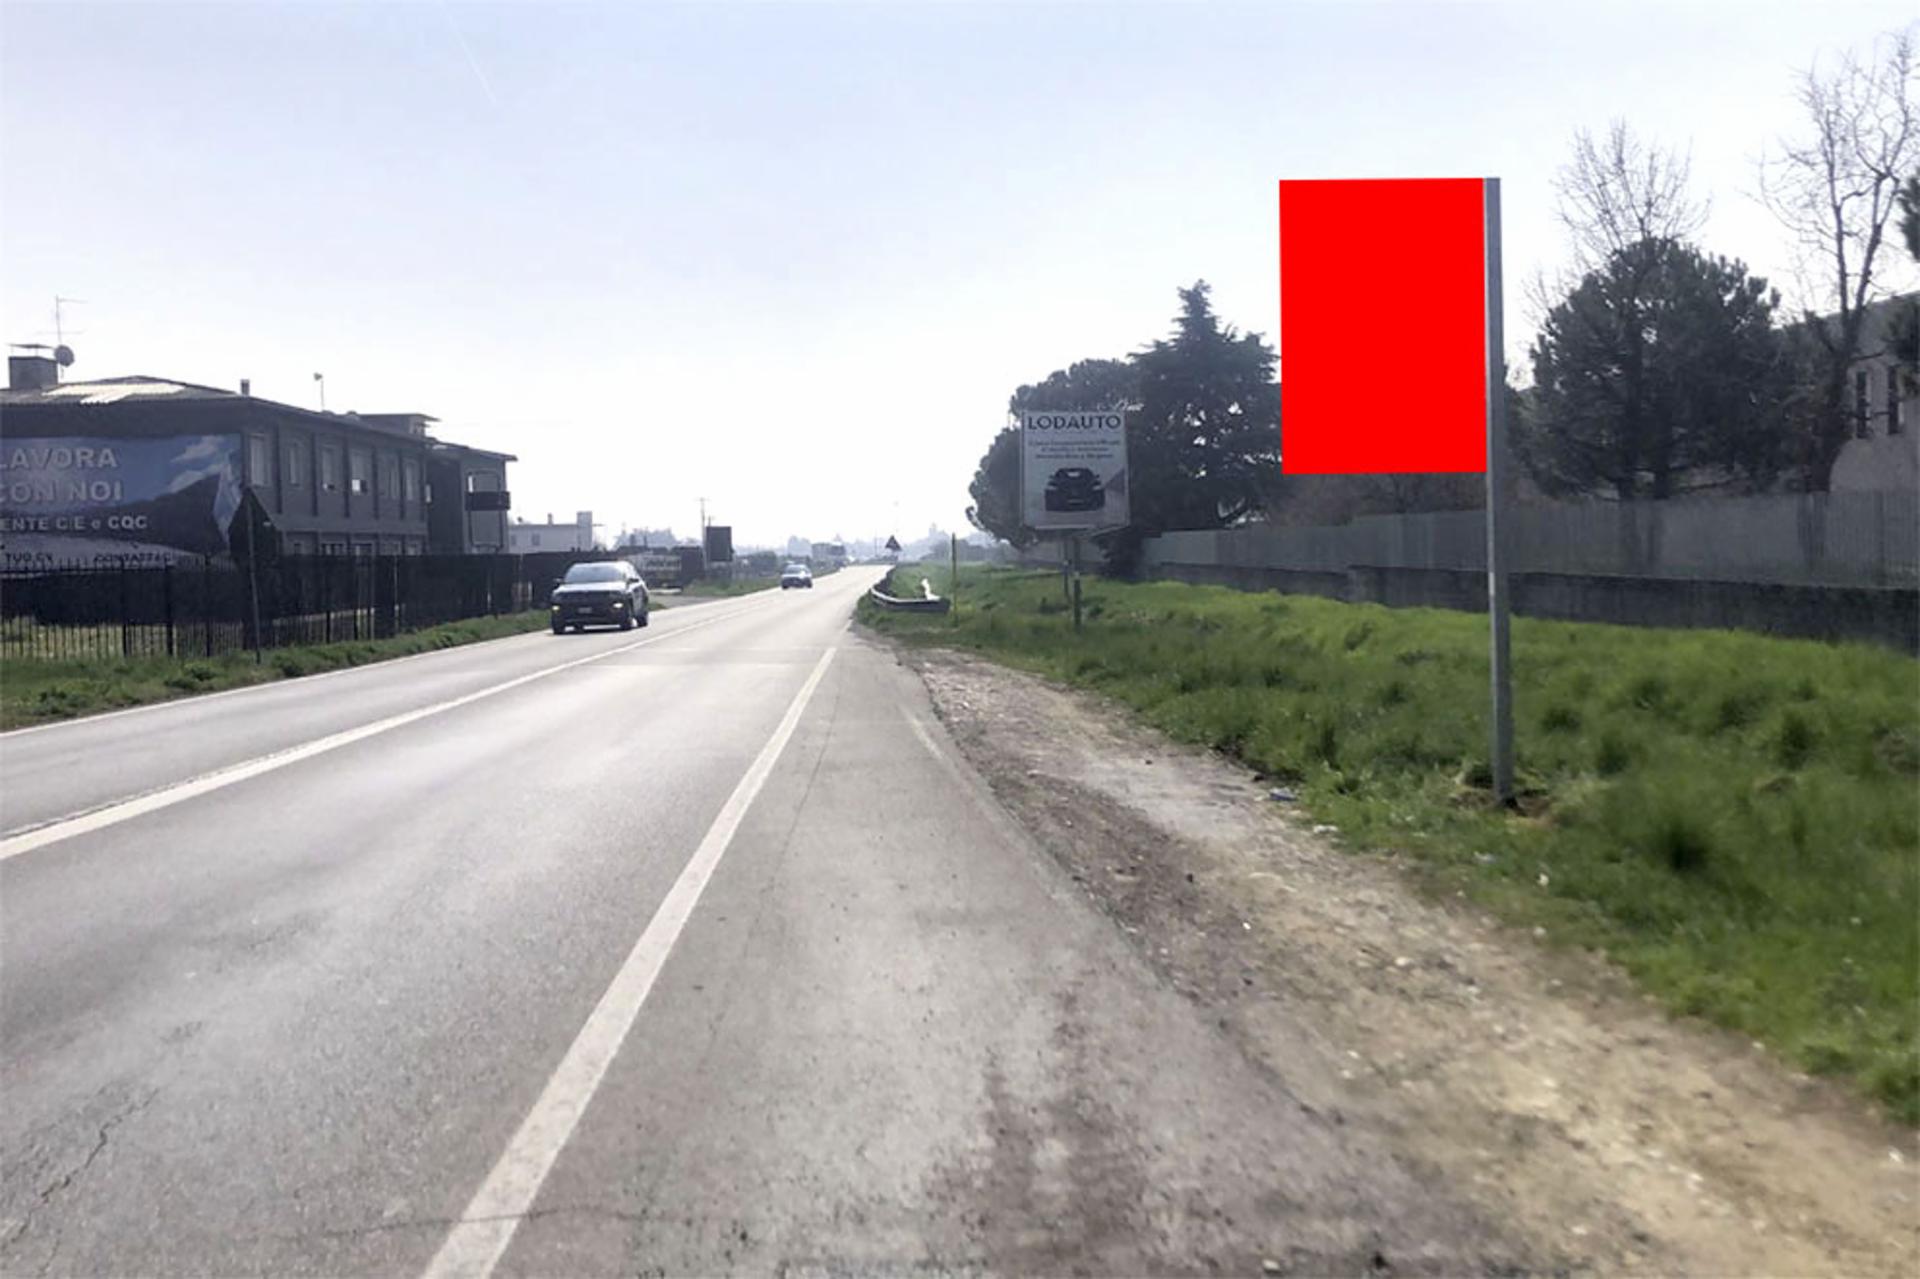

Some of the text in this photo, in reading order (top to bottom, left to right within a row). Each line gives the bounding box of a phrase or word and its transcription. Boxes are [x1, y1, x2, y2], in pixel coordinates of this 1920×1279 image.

[1028, 415, 1121, 430] LODAUTO
[69, 481, 122, 501] NOI
[108, 515, 147, 530] CQC
